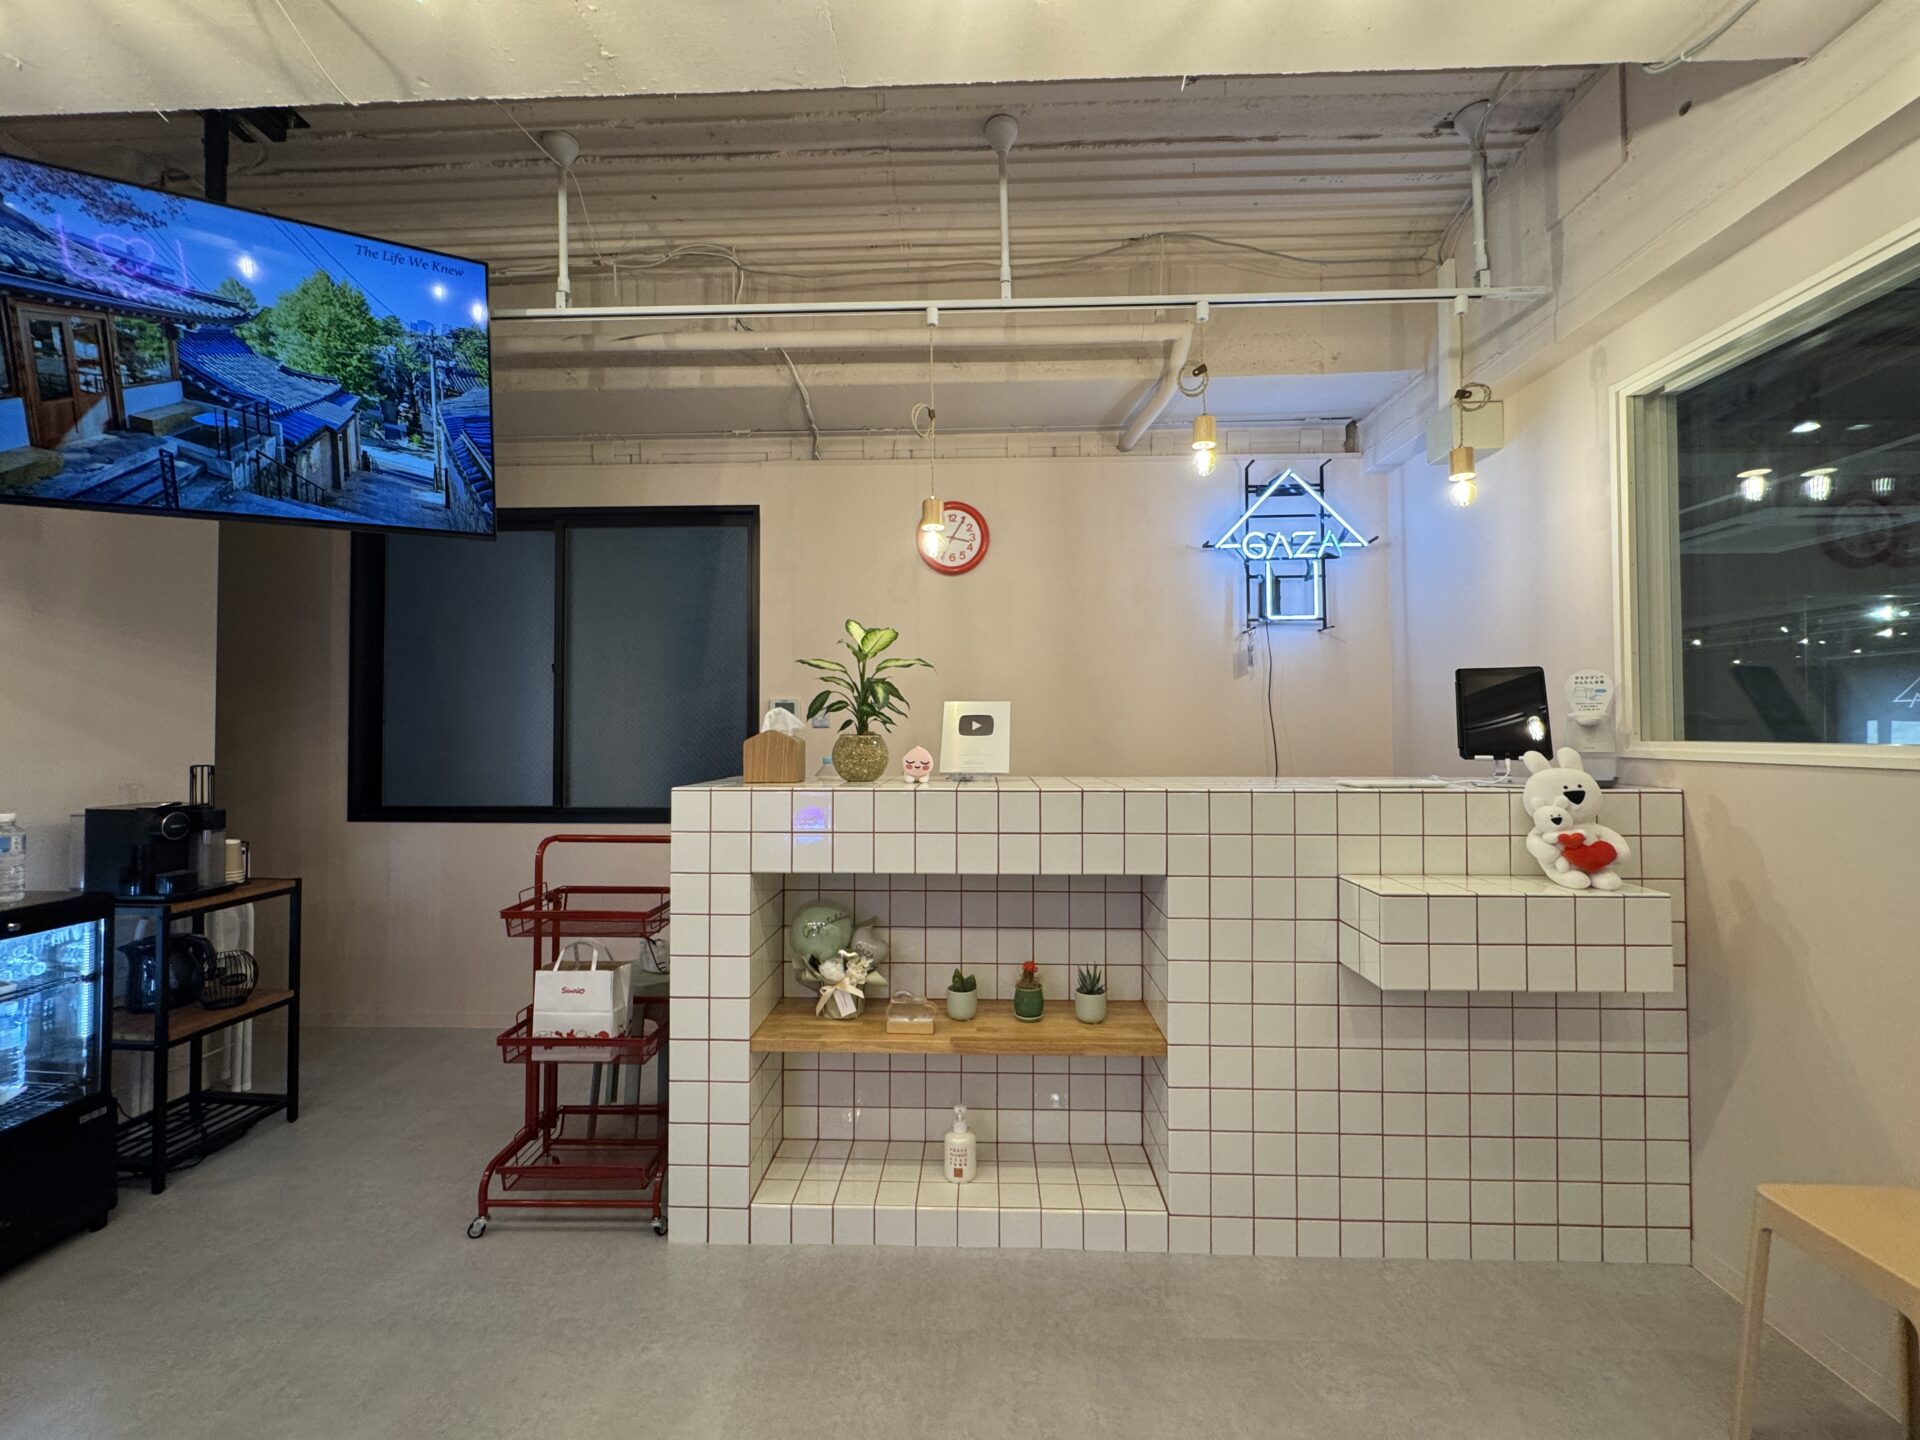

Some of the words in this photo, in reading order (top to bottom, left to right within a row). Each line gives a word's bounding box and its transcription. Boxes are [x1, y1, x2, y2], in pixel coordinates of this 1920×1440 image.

[355, 244, 379, 260] The
[383, 250, 405, 266] Life
[409, 256, 429, 270] We
[432, 261, 464, 277] Knew
[948, 514, 957, 522] 12
[966, 523, 973, 532] 2
[969, 533, 976, 542] 3
[967, 543, 973, 552] 4
[1242, 530, 1343, 560] GAZA
[949, 553, 956, 562] 6
[959, 551, 966, 560] 5
